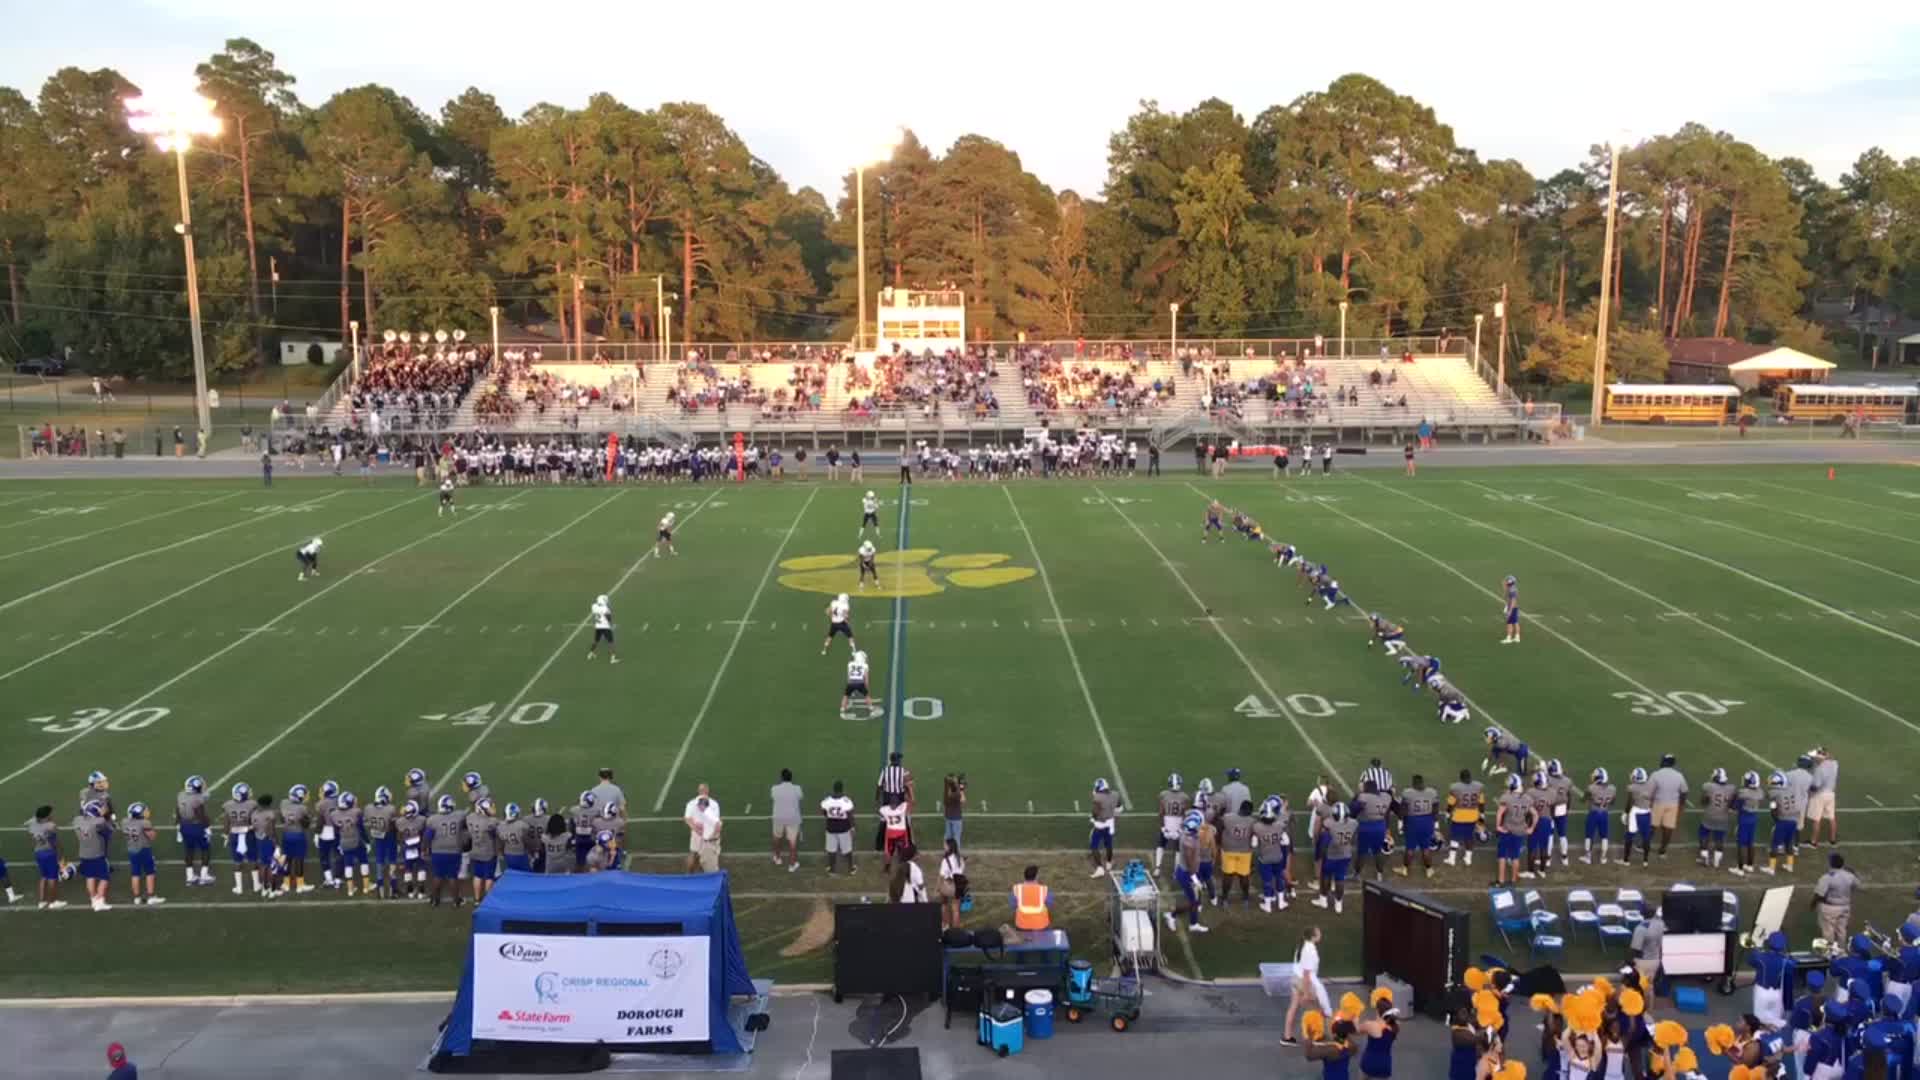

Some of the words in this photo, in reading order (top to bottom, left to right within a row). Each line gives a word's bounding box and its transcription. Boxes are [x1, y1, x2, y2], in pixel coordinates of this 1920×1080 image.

[449, 702, 559, 725] 40
[840, 696, 943, 720] 50
[1234, 693, 1337, 718] 40
[1612, 691, 1729, 716] 30
[41, 707, 171, 733] 30
[562, 977, 593, 987] CRISP
[596, 977, 649, 987] REGIONAL
[617, 1008, 684, 1021] DOROUGH
[627, 1025, 674, 1036] FARMS
